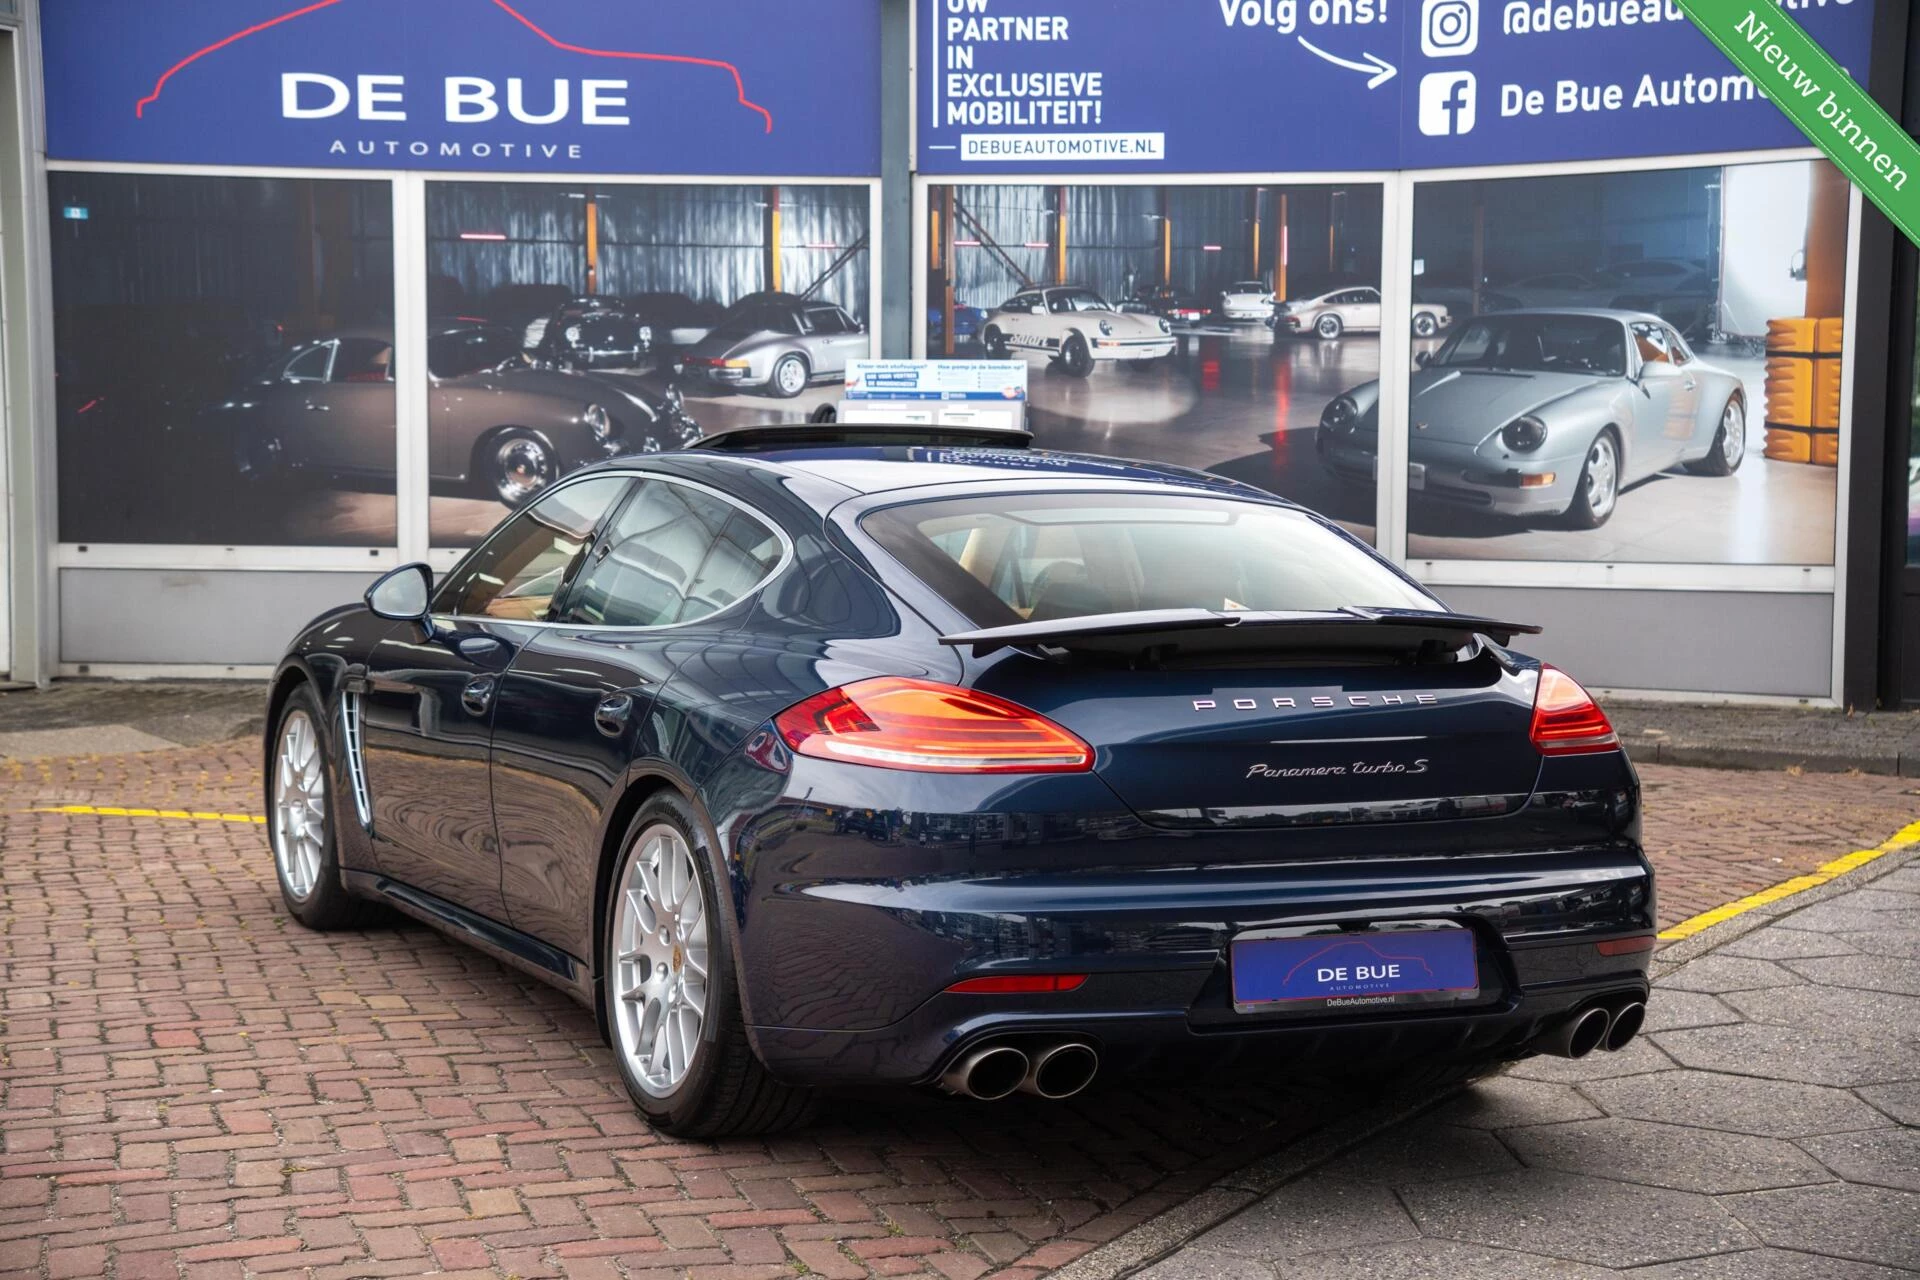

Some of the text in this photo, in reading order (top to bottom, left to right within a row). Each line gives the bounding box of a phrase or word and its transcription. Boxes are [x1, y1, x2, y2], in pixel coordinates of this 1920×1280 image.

[1219, 0, 1388, 34] Volg ons!
[947, 16, 1069, 41] PARTNER
[947, 45, 974, 70] IN
[947, 72, 1102, 97] EXCLUSIEVE
[281, 72, 630, 125] DE BUE
[1501, 83, 1544, 117] De
[1555, 80, 1623, 113] Bue
[947, 100, 1102, 125] MOBILITEIT!
[329, 140, 582, 159] AUTOMOTIVE
[968, 139, 1157, 154] DEBUEAUTOMOTIVE.NL
[1192, 694, 1438, 711] PORSCHE
[1246, 763, 1347, 778] Panamera
[1406, 759, 1429, 774] S
[1317, 964, 1401, 982] DE BUE
[1329, 983, 1390, 991] AUTOMOTIVE
[1326, 995, 1395, 1007] DeBueAutomotive.nl
